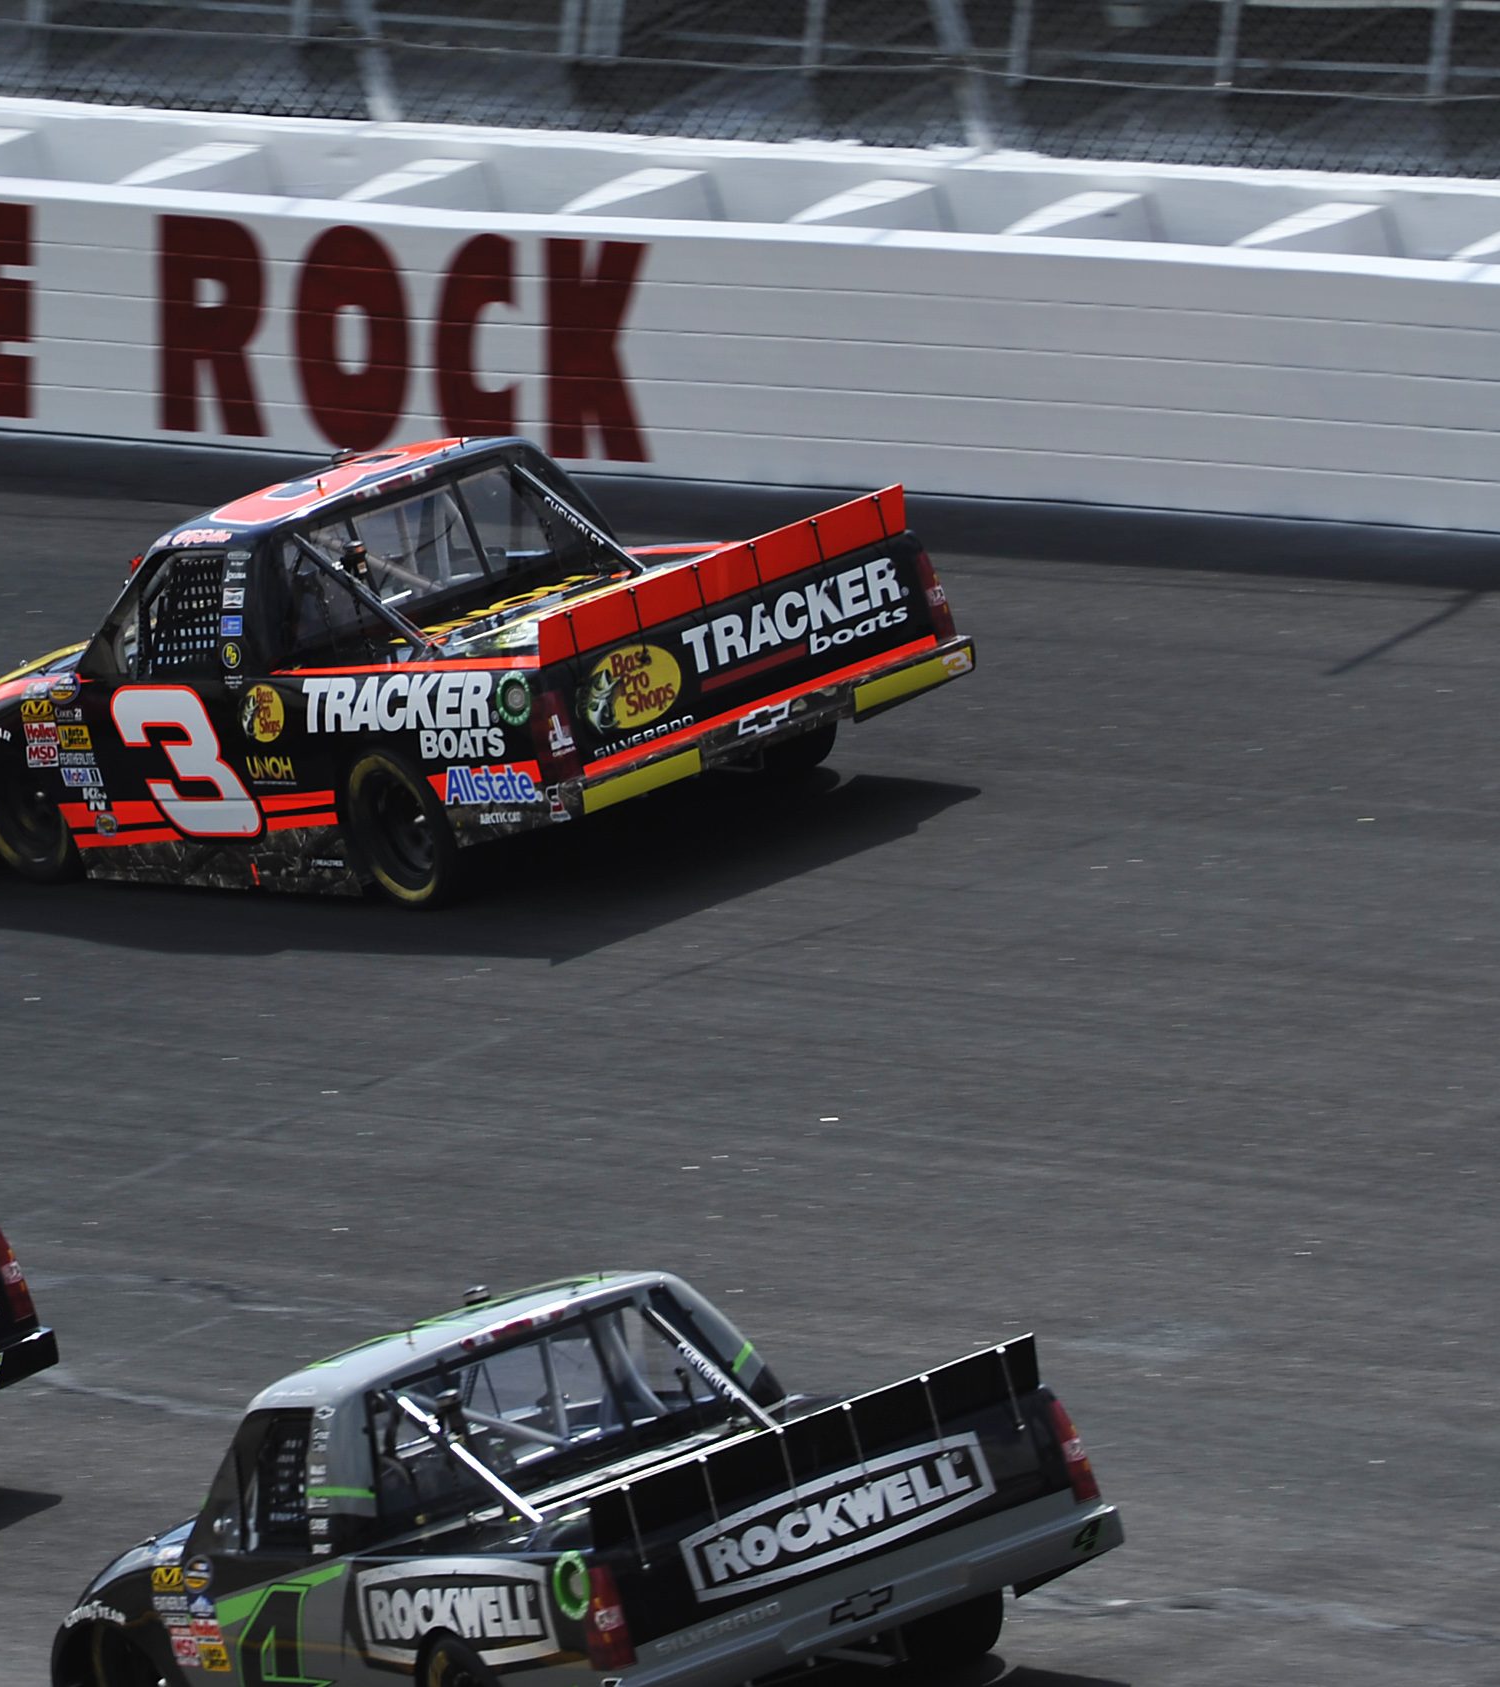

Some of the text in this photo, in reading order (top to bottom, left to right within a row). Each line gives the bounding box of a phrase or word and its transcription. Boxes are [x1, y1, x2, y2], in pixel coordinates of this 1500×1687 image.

[155, 214, 652, 461] ROCK
[681, 557, 901, 674] TRACKER
[810, 606, 908, 655] boats
[609, 650, 652, 678] Bass
[941, 650, 973, 676] 3
[256, 687, 274, 704] Bass
[620, 671, 650, 697] Pro
[626, 683, 675, 717] Shops
[302, 672, 492, 733] TRACKER
[25, 724, 58, 743] Holley
[260, 719, 281, 737] Shops
[420, 728, 505, 759] BOATS
[28, 746, 56, 760] MSD
[110, 685, 262, 838] 3
[246, 756, 295, 779] UNOH
[445, 764, 537, 805] Allstate
[704, 1451, 975, 1584] ROCKWELL
[369, 1585, 543, 1640] ROCKWELL
[655, 1602, 782, 1656] SILVERADO
